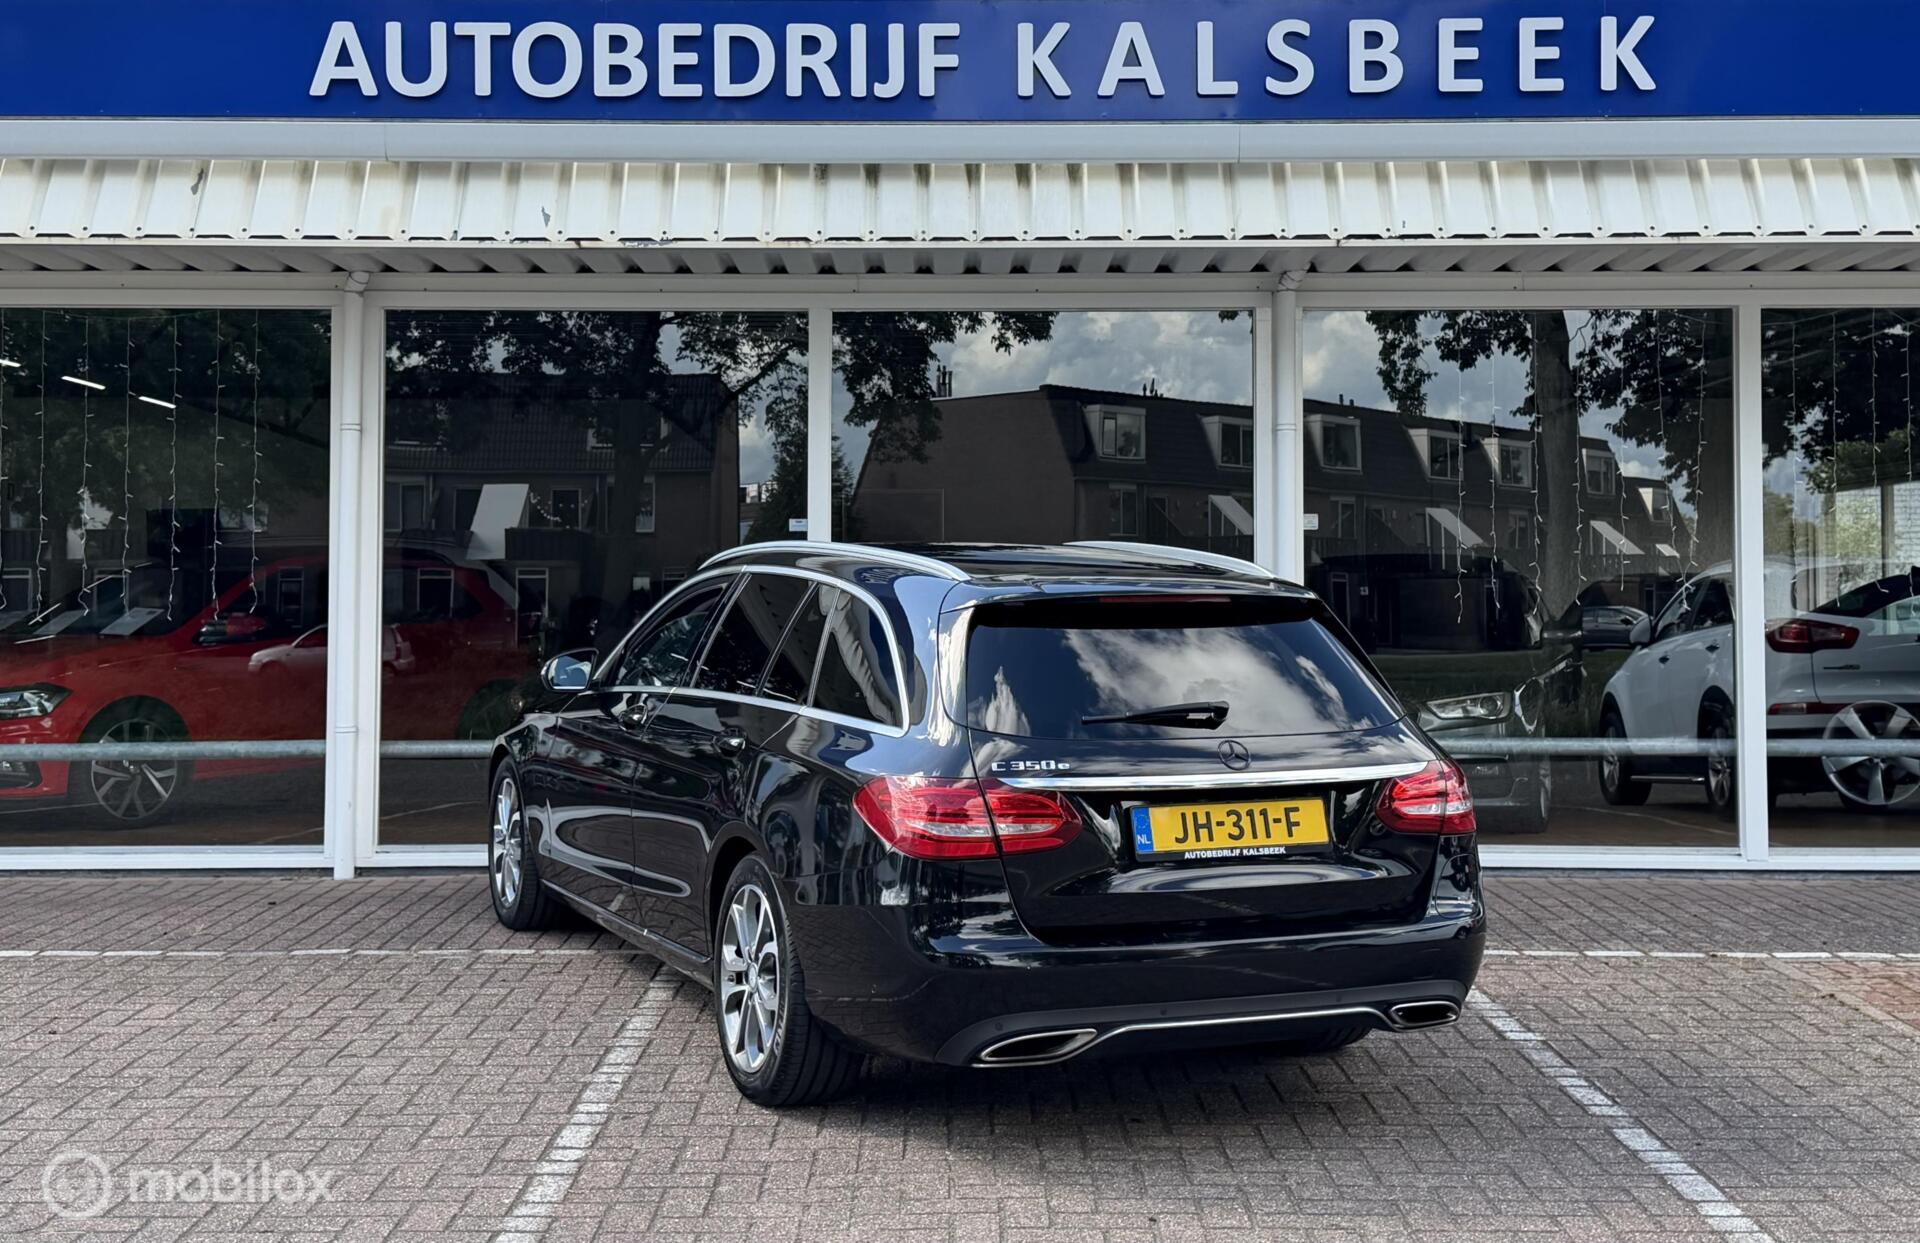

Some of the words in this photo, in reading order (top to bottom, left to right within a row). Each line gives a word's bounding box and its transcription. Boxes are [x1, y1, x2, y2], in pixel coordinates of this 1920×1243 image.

[309, 20, 961, 99] AUTOBEDRIJF
[1017, 15, 1656, 98] KALSBEEK
[991, 761, 1007, 772] C
[1009, 760, 1070, 771] 350e
[1174, 806, 1301, 844] JH-311-F
[1137, 833, 1151, 845] NL
[1184, 848, 1241, 860] AUTOBEDRIJF
[1242, 846, 1286, 857] KALSBEEK
